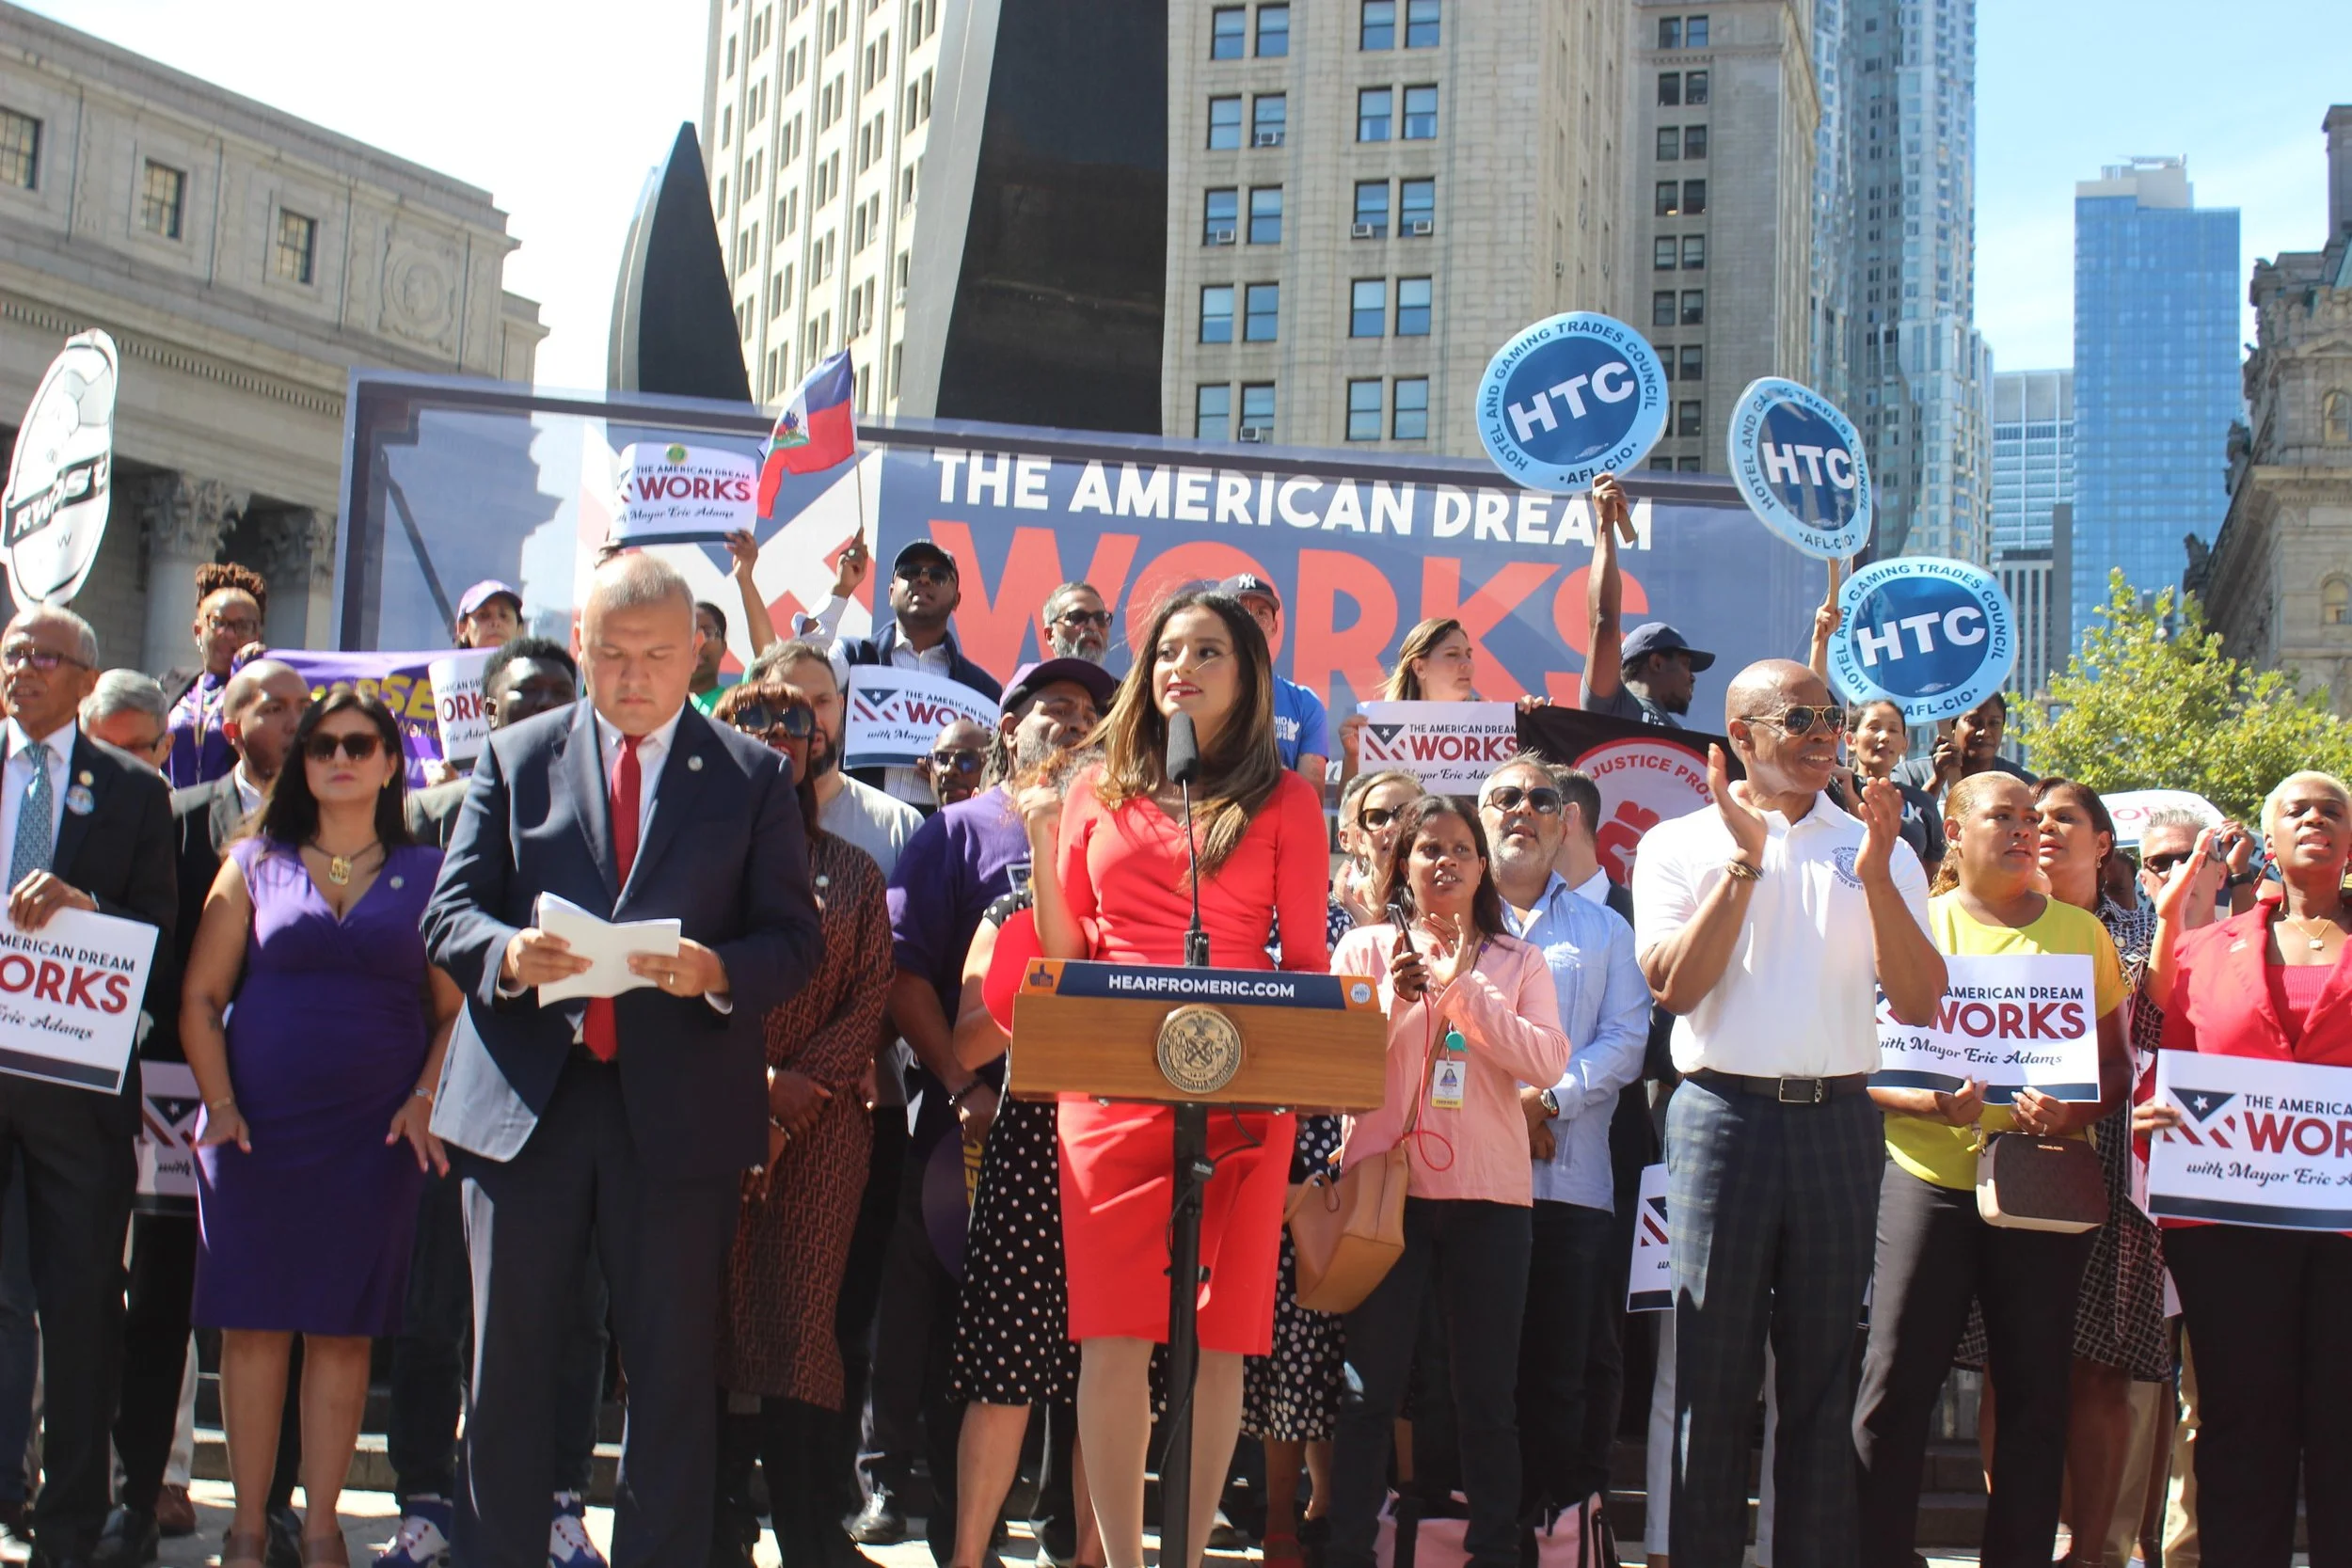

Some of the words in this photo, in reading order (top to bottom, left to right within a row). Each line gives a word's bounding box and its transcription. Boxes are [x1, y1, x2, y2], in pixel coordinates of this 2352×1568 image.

[1555, 321, 1625, 343] TRADES
[1494, 328, 1550, 380] GAMING
[1625, 341, 1658, 410] COUNCIL
[1486, 385, 1500, 419] AND
[1507, 361, 1635, 443] HTC
[1490, 423, 1529, 470] HOTEL
[1742, 416, 1756, 449] AND
[636, 465, 655, 475] THE
[657, 464, 712, 476] AMERICAN
[714, 468, 750, 480] DREAM
[1761, 442, 1855, 490] HTC
[636, 476, 752, 502] WORKS
[933, 447, 1052, 511] THE
[1068, 459, 1414, 535] AMERICAN
[1743, 456, 1774, 511] HOTEL
[629, 508, 666, 524] Mayor
[696, 506, 734, 519] Adams
[1804, 533, 1852, 550] AFL-CIO
[1848, 564, 1910, 601] GAMING
[1915, 563, 1983, 590] TRADES
[1835, 605, 1852, 640] AND
[1856, 606, 1986, 668] HTC
[1981, 590, 2007, 660] COUNCIL
[1836, 644, 1868, 695] HOTEL
[905, 690, 924, 700] THE
[927, 694, 977, 717] AMERICAN
[1904, 692, 1974, 717] AFL-CIO
[867, 728, 892, 741] with
[894, 729, 934, 745] Mayor
[1409, 724, 1427, 734] THE
[1429, 724, 1483, 734] AMERICAN
[1409, 736, 1518, 761] WORKS
[1440, 768, 1464, 780] Eric
[1591, 754, 1673, 780] JUSTICE
[0, 934, 74, 962] MERICAN
[78, 948, 135, 973] DREAM
[0, 955, 132, 1016] ORKS
[1108, 974, 1295, 998] HEARFROMERIC.COM
[1945, 987, 2026, 1000] AMERICAN
[2030, 987, 2084, 1000] DREAM
[29, 1011, 94, 1040] Adams
[1909, 1037, 1962, 1060] Mayor
[1963, 1048, 1998, 1064] Eric
[2002, 1051, 2063, 1066] Adams
[2245, 1094, 2274, 1110] THE
[2278, 1099, 2352, 1117] AMERICA
[2243, 1111, 2352, 1159] WOR
[2186, 1162, 2224, 1180] with
[2227, 1163, 2290, 1187] Mayor
[2294, 1167, 2332, 1186] Eric
